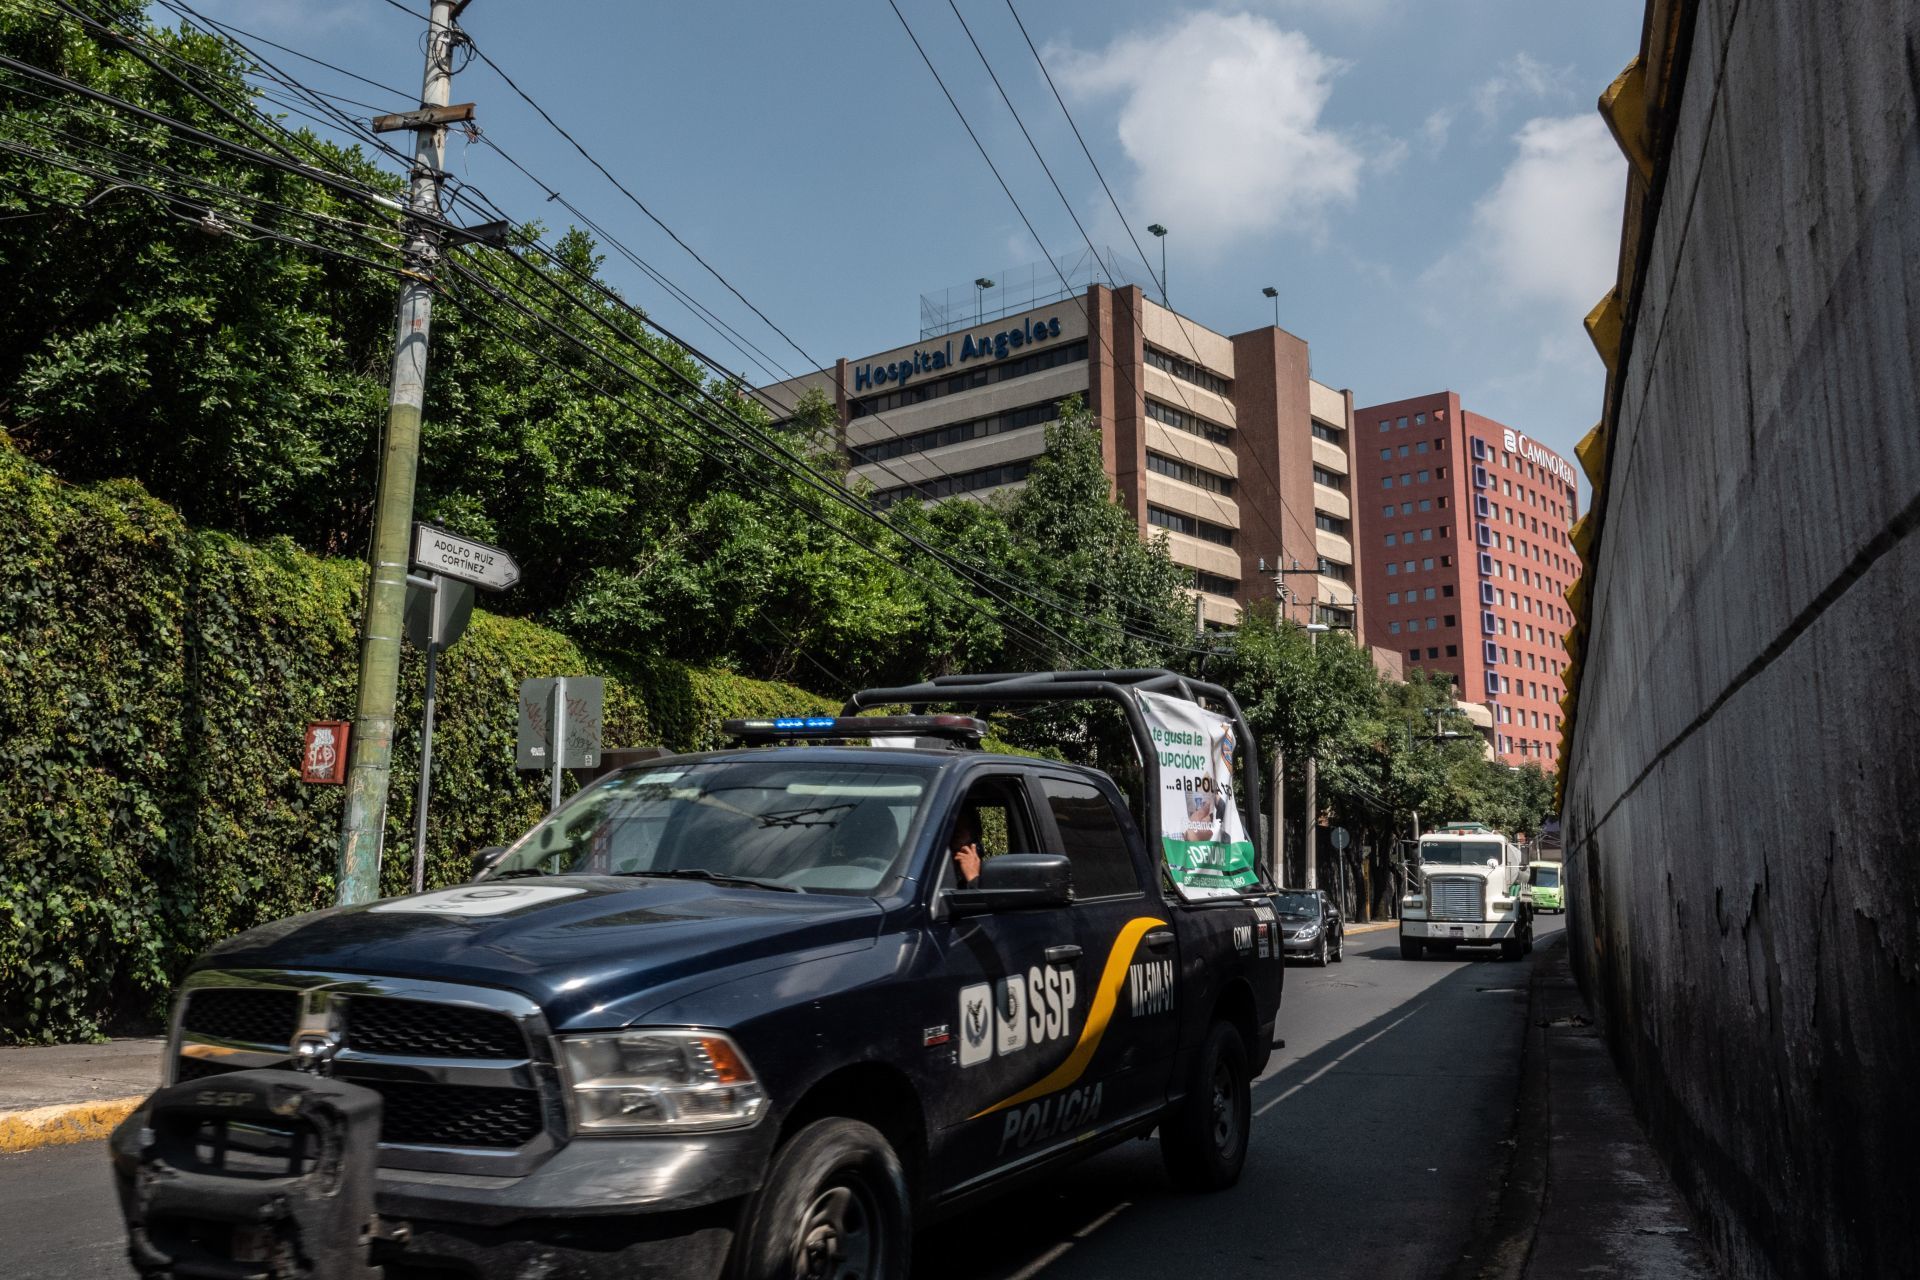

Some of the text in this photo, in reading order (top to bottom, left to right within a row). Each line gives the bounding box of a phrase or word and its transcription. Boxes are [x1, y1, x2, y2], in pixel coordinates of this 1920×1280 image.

[855, 316, 1061, 391] Hospital Angeles
[1518, 434, 1560, 475] CAMINO
[434, 539, 470, 558] ADOLFO
[1153, 727, 1203, 747] te gusta la
[1157, 750, 1206, 770] UPCIÓN?
[1184, 775, 1193, 792] la
[1028, 964, 1077, 1044] SSP
